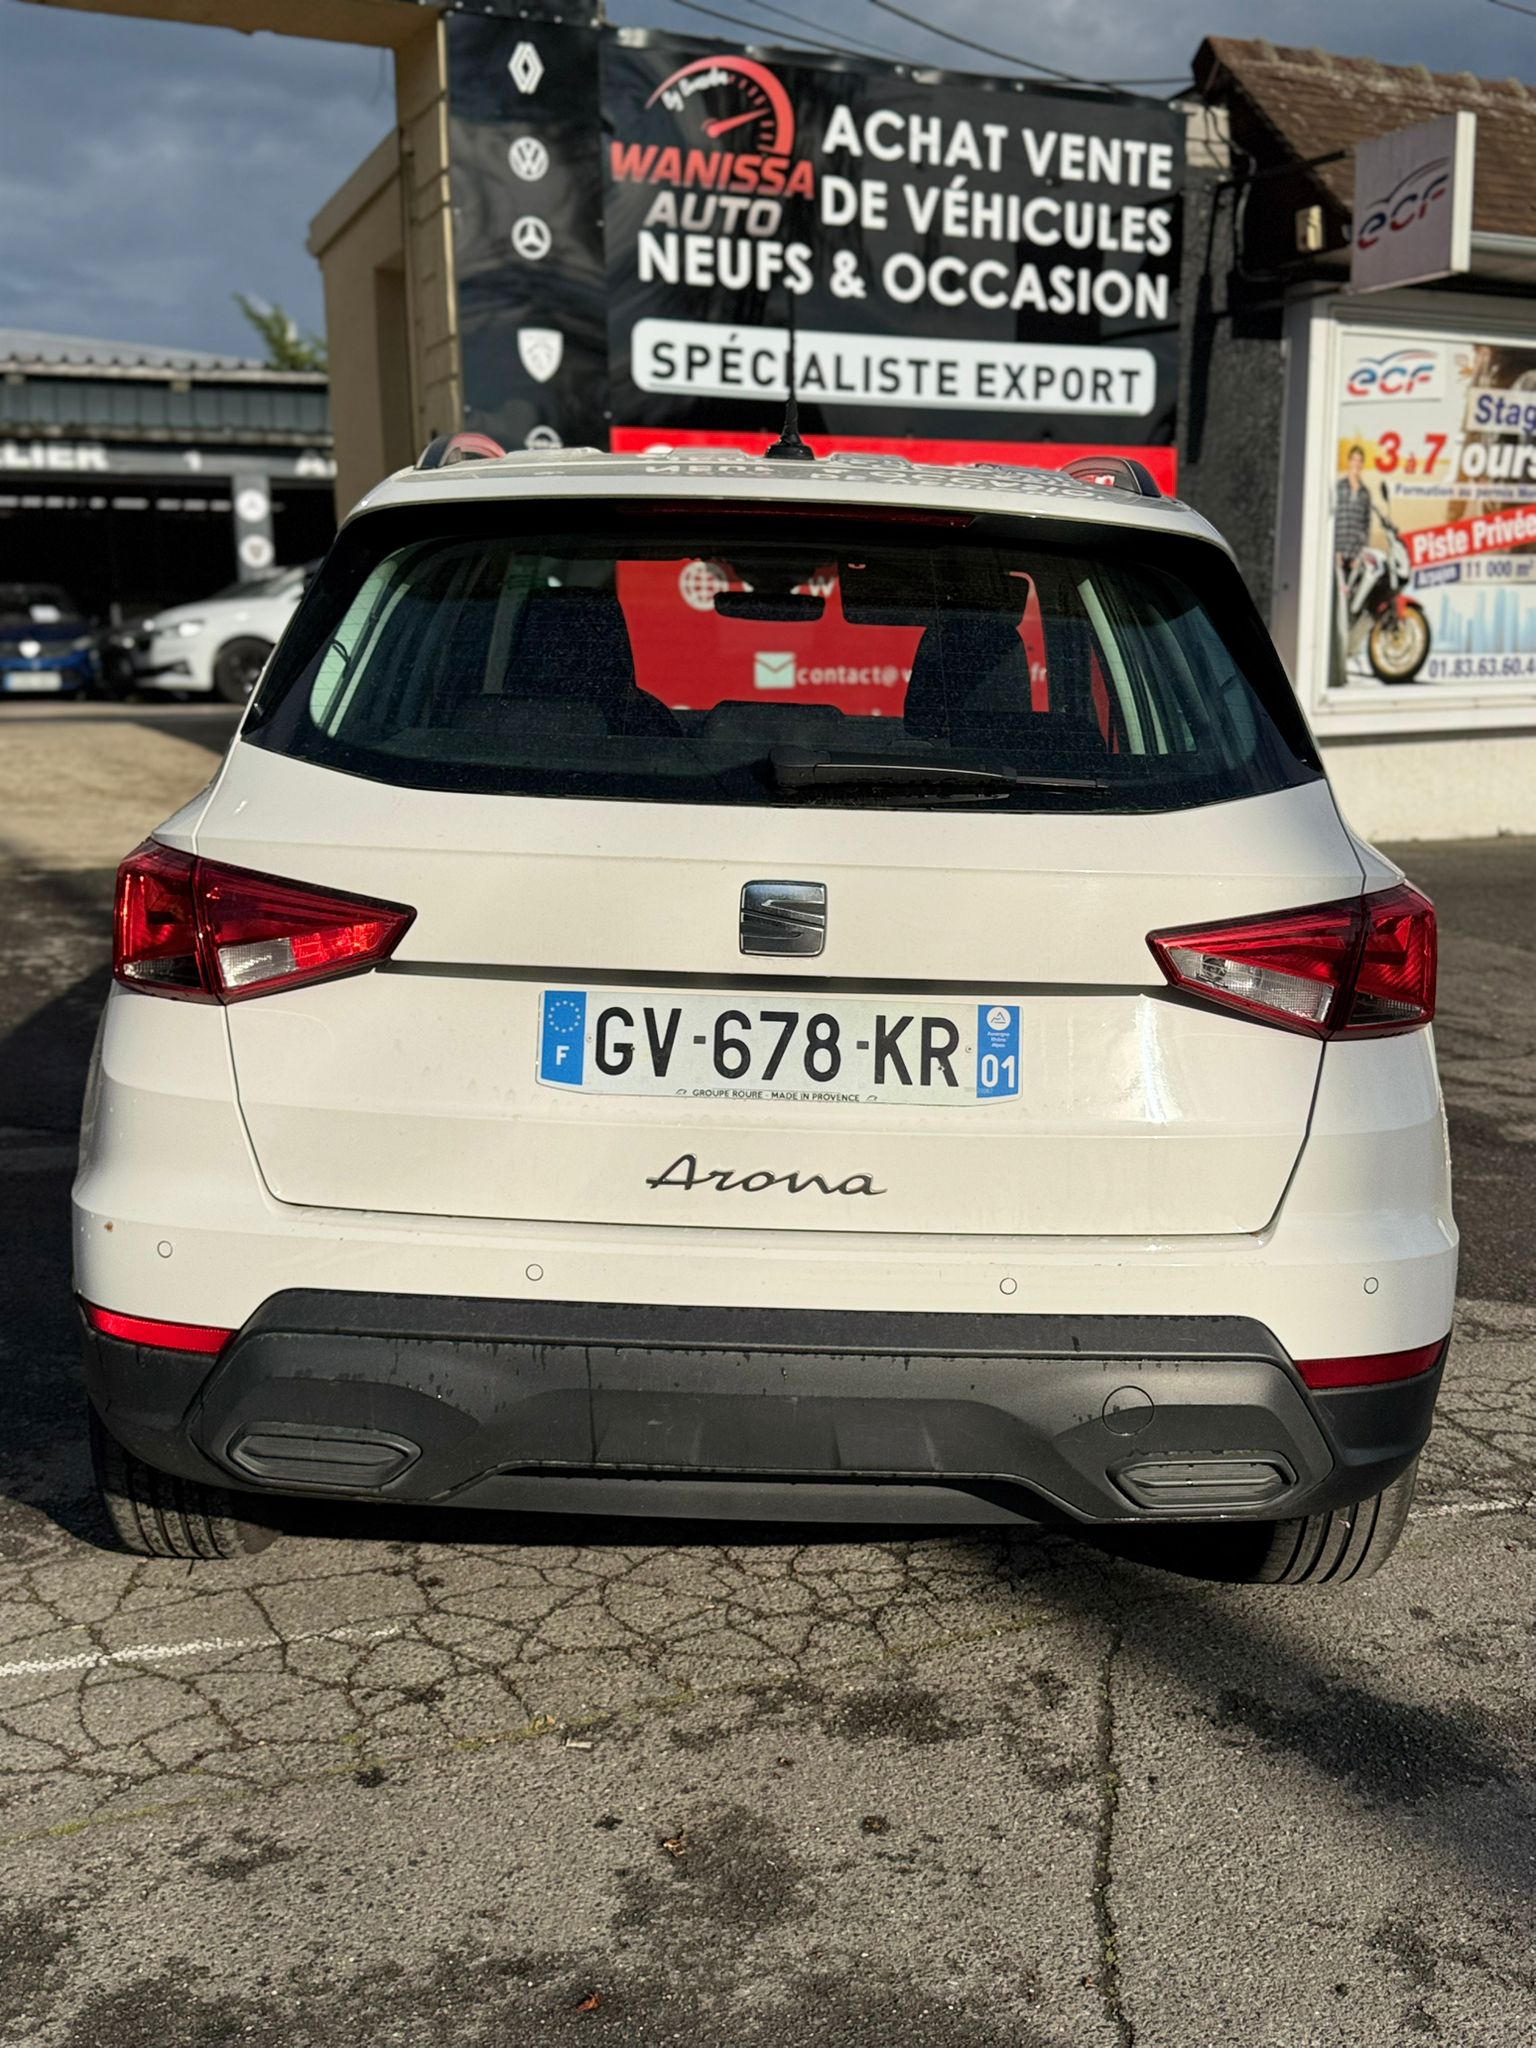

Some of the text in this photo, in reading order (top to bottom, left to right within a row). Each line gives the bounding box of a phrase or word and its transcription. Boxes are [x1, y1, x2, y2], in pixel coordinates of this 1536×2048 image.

[611, 140, 815, 200] WANISSA
[821, 105, 1173, 190] ACHAT VENTE
[643, 190, 782, 237] AUTO
[821, 175, 1172, 256] DE VÉHICULES
[638, 230, 1169, 320] NEUFS & OCCASION
[652, 333, 1140, 404] SPÉCIALISTE EXPORT
[0, 441, 109, 471] LIER
[1375, 430, 1402, 474] 3
[1405, 451, 1418, 475] à
[1423, 432, 1448, 475] 7
[1412, 527, 1469, 564] Piste
[1466, 561, 1482, 578] 11
[1487, 560, 1512, 578] 000
[556, 1045, 570, 1066] F
[981, 1053, 1015, 1088] 01
[692, 1088, 729, 1098] GROUPE
[731, 1089, 763, 1099] ROURE
[771, 1091, 798, 1100] MADE
[800, 1092, 810, 1100] IN
[811, 1093, 860, 1102] PROVENCE
[646, 1151, 888, 1196] Arona
